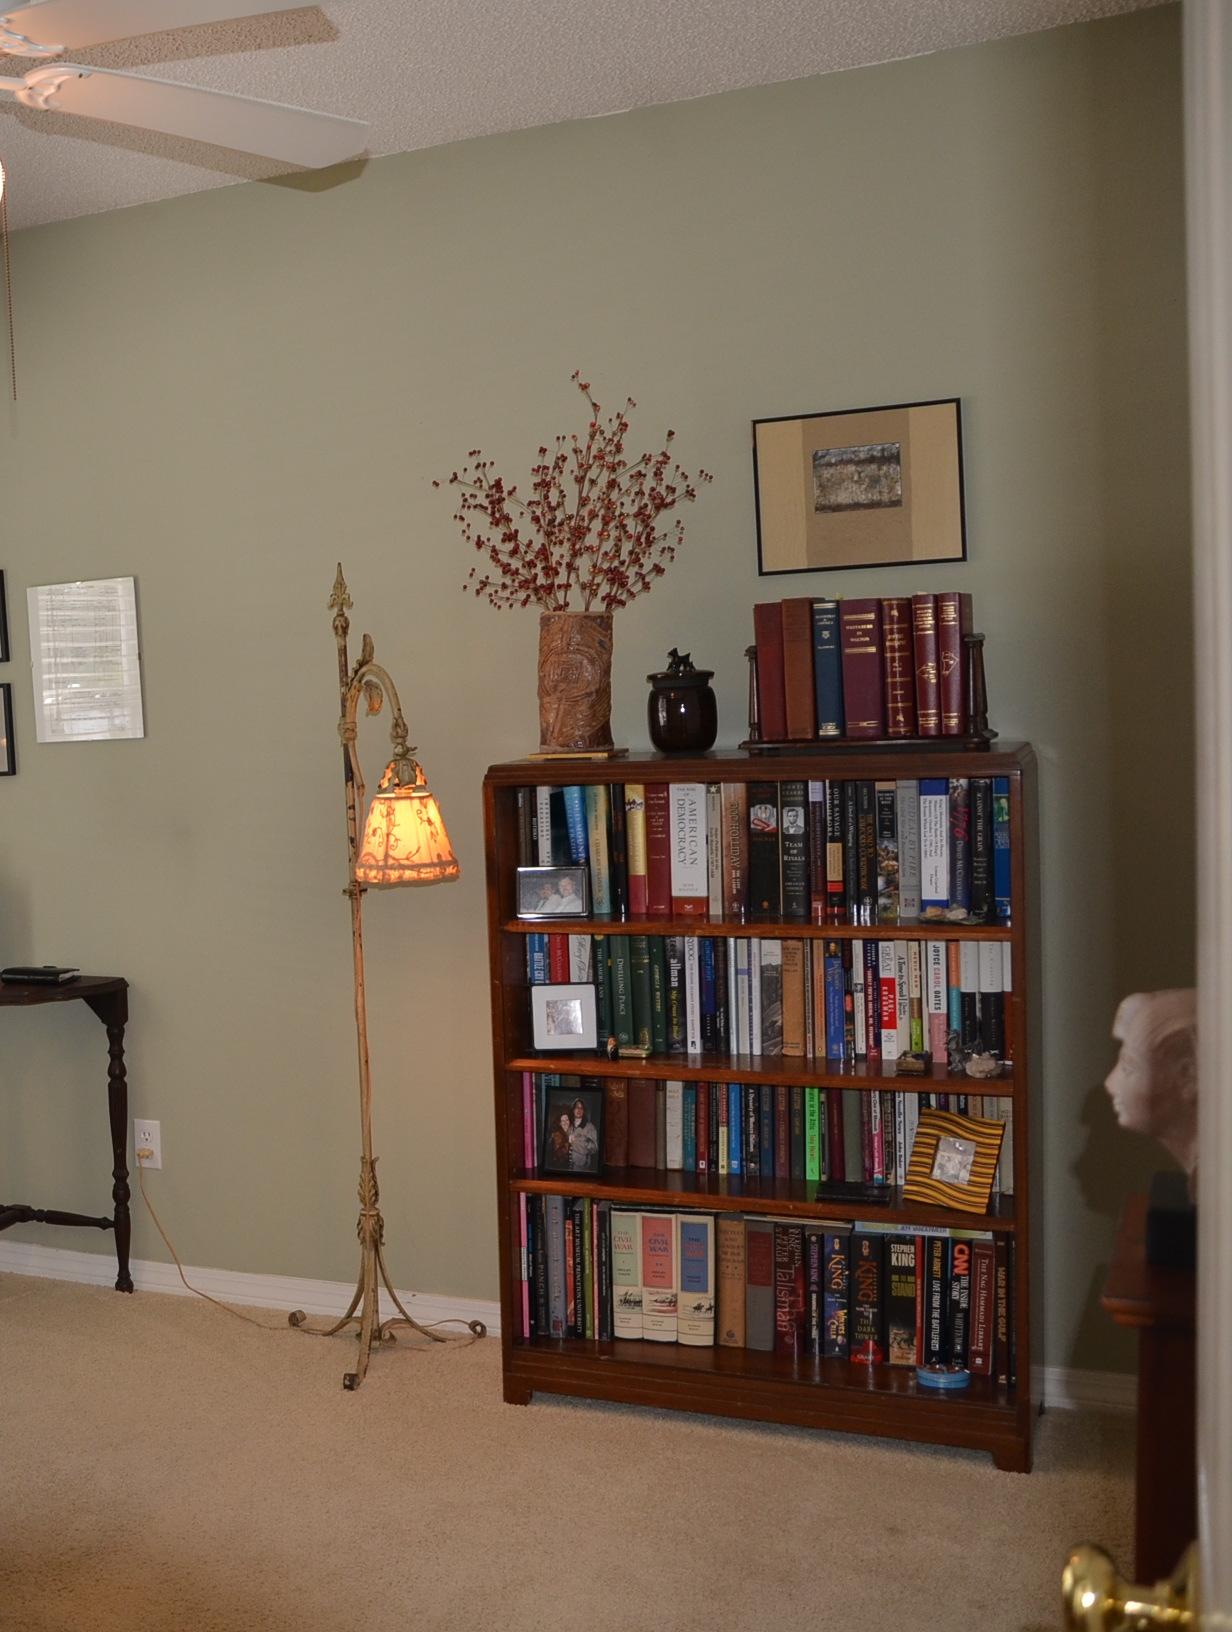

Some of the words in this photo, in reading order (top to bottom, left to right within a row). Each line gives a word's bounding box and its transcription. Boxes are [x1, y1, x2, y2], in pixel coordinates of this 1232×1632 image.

[908, 796, 917, 836] ORDEAL
[976, 792, 984, 818] AGAINST
[677, 798, 687, 864] DEMOCRACY
[688, 799, 698, 865] AMERICAN
[950, 807, 971, 841] 1776
[976, 819, 984, 830] THE
[730, 823, 740, 867] HOLLIDAY
[909, 840, 917, 851] BY
[956, 840, 964, 859] David
[976, 832, 984, 851] GRAIN
[533, 952, 544, 970] BATTLE
[933, 944, 941, 966] JOYCE
[534, 970, 544, 980] CRY
[616, 958, 625, 994] DWELLING
[670, 958, 682, 987] allman
[933, 967, 942, 990] CAROL
[898, 981, 906, 998] Speak
[934, 990, 942, 1011] OATES
[618, 995, 626, 1016] PLACE
[775, 1227, 783, 1262] STRAUB
[788, 1228, 796, 1250] KING
[793, 1228, 802, 1267] STEPHEN
[891, 1244, 915, 1253] STEPHEN
[933, 1240, 942, 1257] PETER
[810, 1243, 818, 1268] STEPHEN
[891, 1253, 915, 1267] KING
[952, 1244, 971, 1276] CNN
[980, 1258, 989, 1272] THE
[537, 1264, 545, 1295] PUNCH
[828, 1254, 843, 1290] KING
[932, 1258, 942, 1280] ARNETT
[997, 1267, 1005, 1287] WAR
[855, 1260, 874, 1303] KING
[931, 1280, 941, 1291] LIVE
[951, 1281, 960, 1301] STORY
[959, 1276, 969, 1288] THE
[979, 1274, 988, 1289] NAG
[776, 1265, 795, 1332] Talisman
[931, 1292, 941, 1308] FROM
[959, 1289, 969, 1309] INSIDE
[997, 1288, 1006, 1298] IN
[931, 1309, 940, 1319] THE
[978, 1290, 988, 1322] HAMMADI
[998, 1299, 1006, 1317] THE
[837, 1310, 847, 1335] WOLVES
[998, 1318, 1007, 1343] GULF
[855, 1332, 878, 1340] TOWER
[930, 1319, 940, 1351] BATTLEFIELD
[977, 1324, 986, 1352] LIBRARY
